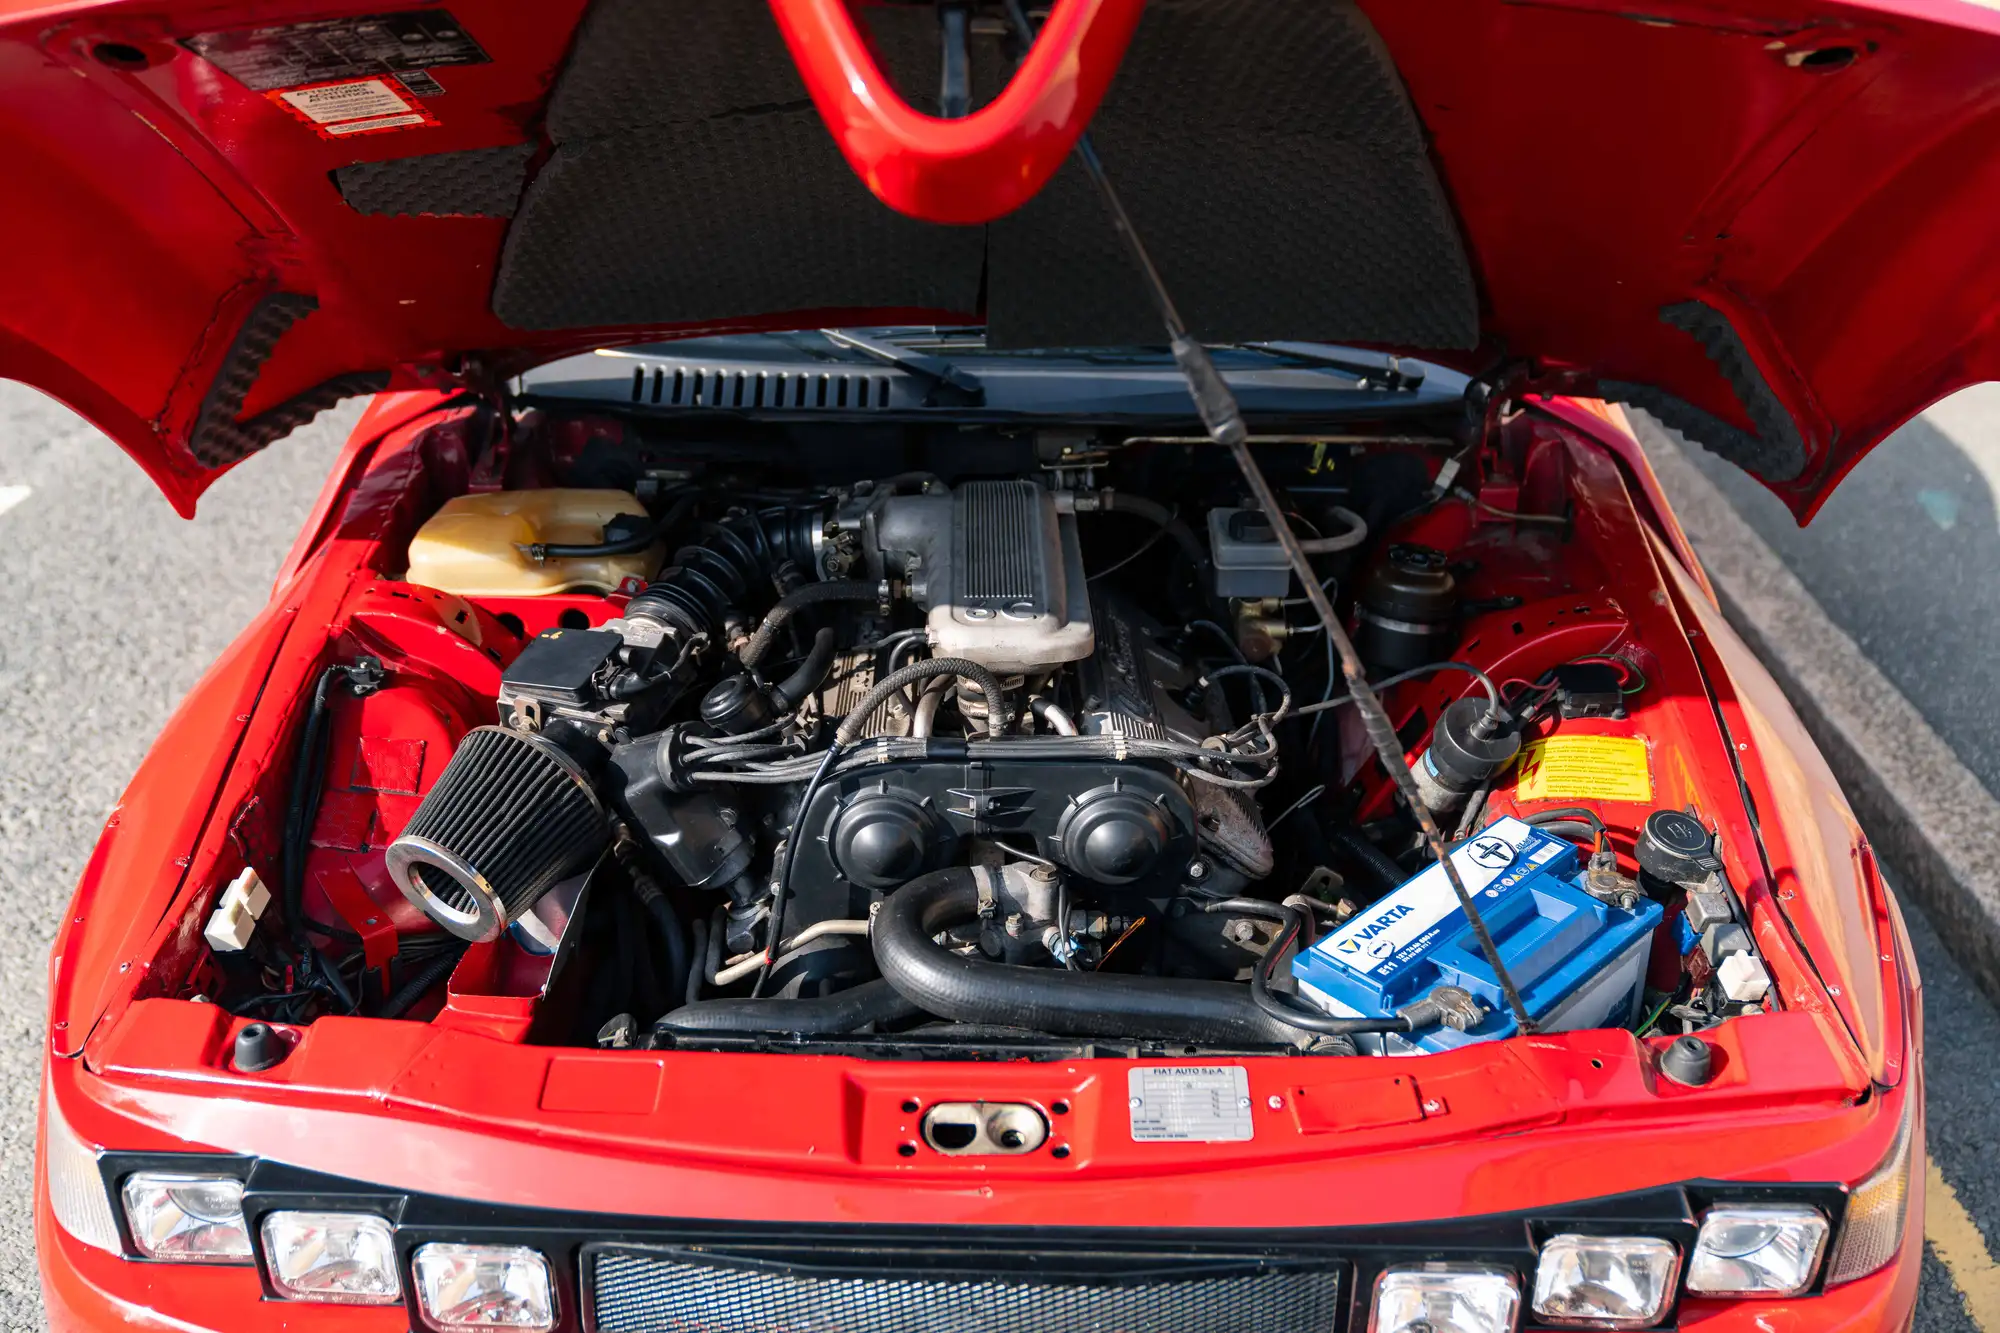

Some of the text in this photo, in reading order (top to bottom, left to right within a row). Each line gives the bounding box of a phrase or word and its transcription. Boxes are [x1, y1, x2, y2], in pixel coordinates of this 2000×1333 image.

[1354, 904, 1415, 940] VARTA
[1377, 961, 1398, 976] E11
[1175, 1067, 1199, 1075] AUTO
